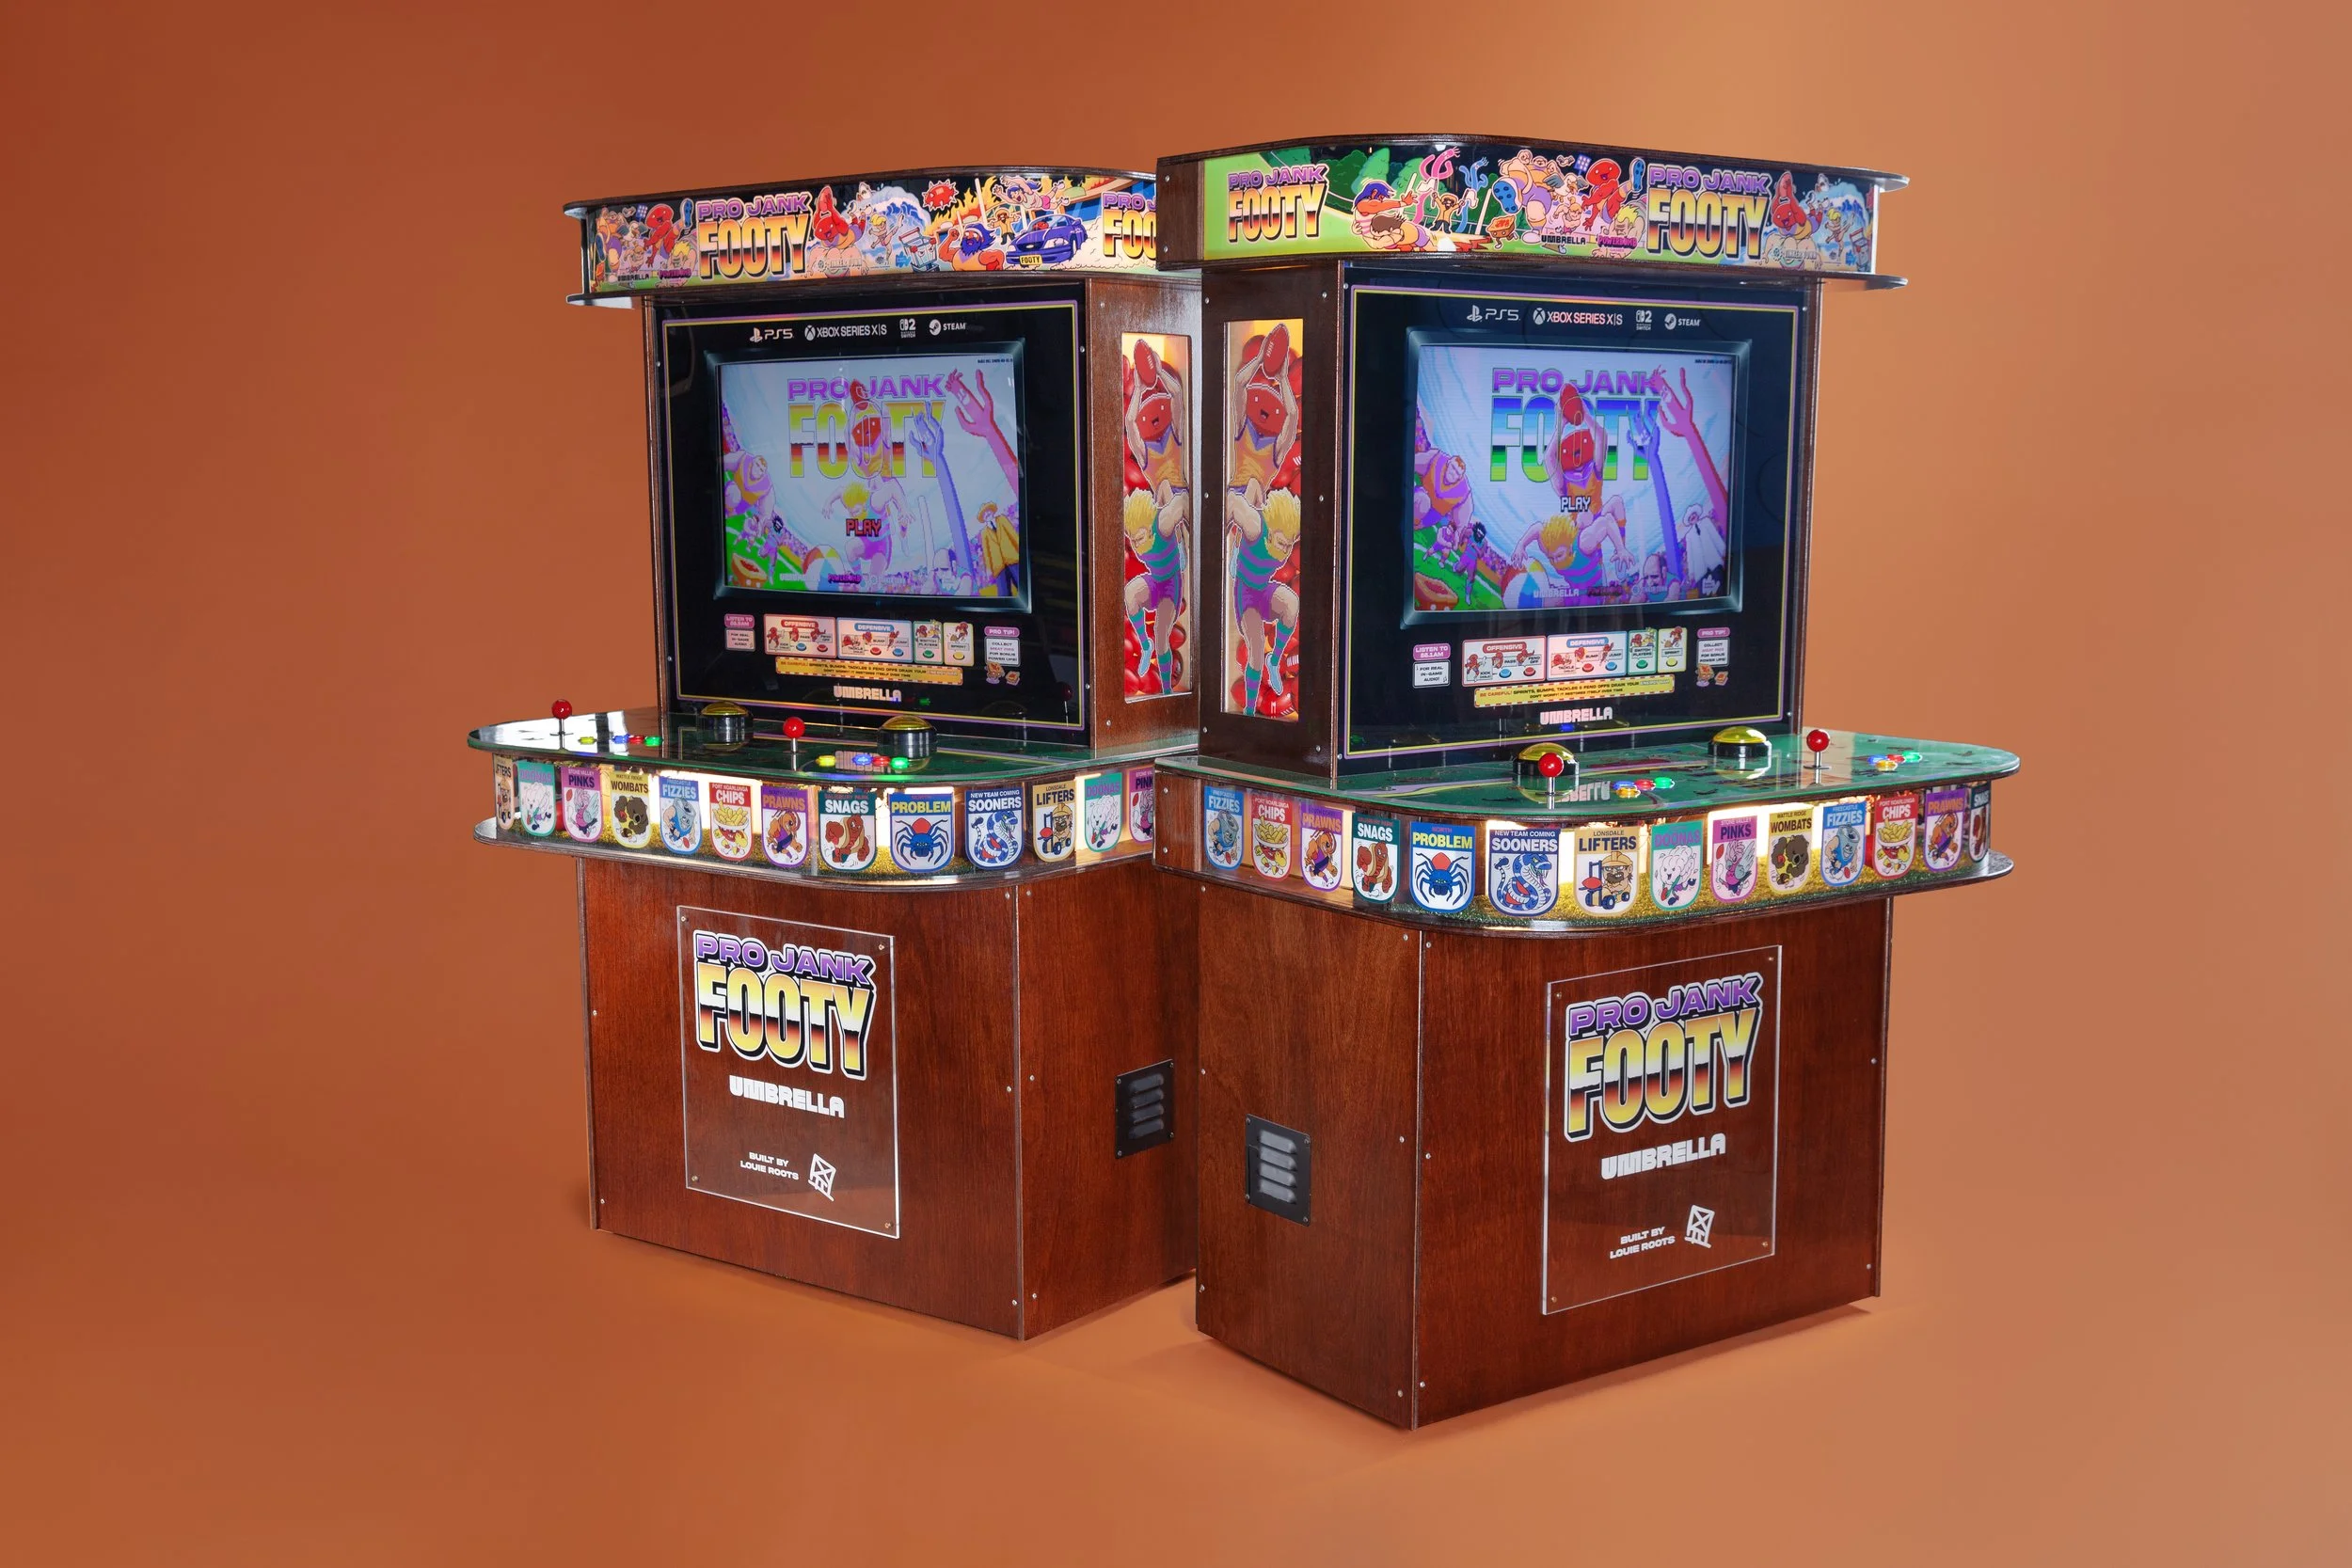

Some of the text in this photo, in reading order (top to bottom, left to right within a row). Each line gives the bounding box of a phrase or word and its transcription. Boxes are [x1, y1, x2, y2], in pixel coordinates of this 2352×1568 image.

[1229, 166, 1327, 189] PRO JANK
[1648, 166, 1769, 194] PRO JANK
[698, 194, 810, 219] PRO JANK
[1103, 193, 1145, 210] PRO
[1229, 183, 1327, 242] FOOTY
[1647, 189, 1770, 260] FOOTY
[1103, 209, 1156, 260] FOO
[1541, 235, 1586, 245] UMBRELLA
[699, 214, 810, 279] FOOTY
[1021, 256, 1041, 264] FOOTY
[1486, 309, 1519, 322] PS5
[1547, 311, 1572, 323] XBOX
[1574, 312, 1605, 325] SERIES
[764, 328, 793, 340] PS5
[817, 326, 839, 338] XBOX
[841, 325, 870, 337] SERIES
[787, 374, 946, 401] PRO JANK
[1491, 367, 1564, 394] PRO
[788, 401, 946, 480] FOOTY
[1561, 496, 1591, 512] PLAY
[846, 518, 882, 537] PLAY
[834, 686, 901, 702] UMBRELLA
[1540, 706, 1613, 724] UMBRELLA
[568, 775, 595, 788] PINKS
[612, 781, 648, 793] WOMBATS
[1136, 776, 1153, 790] PINK
[662, 784, 696, 799] FIZZIES
[716, 789, 745, 805] CHIPS
[1037, 788, 1074, 806] LIFTERS
[763, 795, 805, 811] PRAWNS
[825, 800, 869, 814] SNAGS
[891, 801, 951, 813] PROBLEM
[968, 797, 1022, 812] SOONERS
[1208, 796, 1240, 814] FIZZIES
[1882, 804, 1911, 819] CHIPS
[1928, 798, 1963, 815] PRAWNS
[1258, 804, 1285, 822] CHIPS
[1827, 811, 1863, 827] FIZZIES
[1302, 813, 1341, 832] PRAWNS
[1771, 818, 1812, 833] WOMBATS
[1358, 823, 1393, 842] SNAGS
[1412, 832, 1472, 848] PROBLEM
[1655, 830, 1700, 847] DOONAS
[1721, 824, 1752, 840] PINKS
[1491, 837, 1558, 852] SOONERS
[1579, 836, 1637, 852] LIFTERS
[695, 933, 874, 986] PRO JANK
[1569, 975, 1762, 1037] PRO JANK
[696, 960, 874, 1077] FOOTY
[1567, 1006, 1758, 1139] FOOTY
[729, 1074, 845, 1118] UMBRELLA
[749, 1152, 789, 1168] BUILT BY
[1601, 1133, 1725, 1180] UMBRELLA
[740, 1161, 800, 1180] LOUIE ROOTS
[1620, 1226, 1665, 1244] BUILT BY
[1610, 1236, 1676, 1259] LOUIE ROOTS
